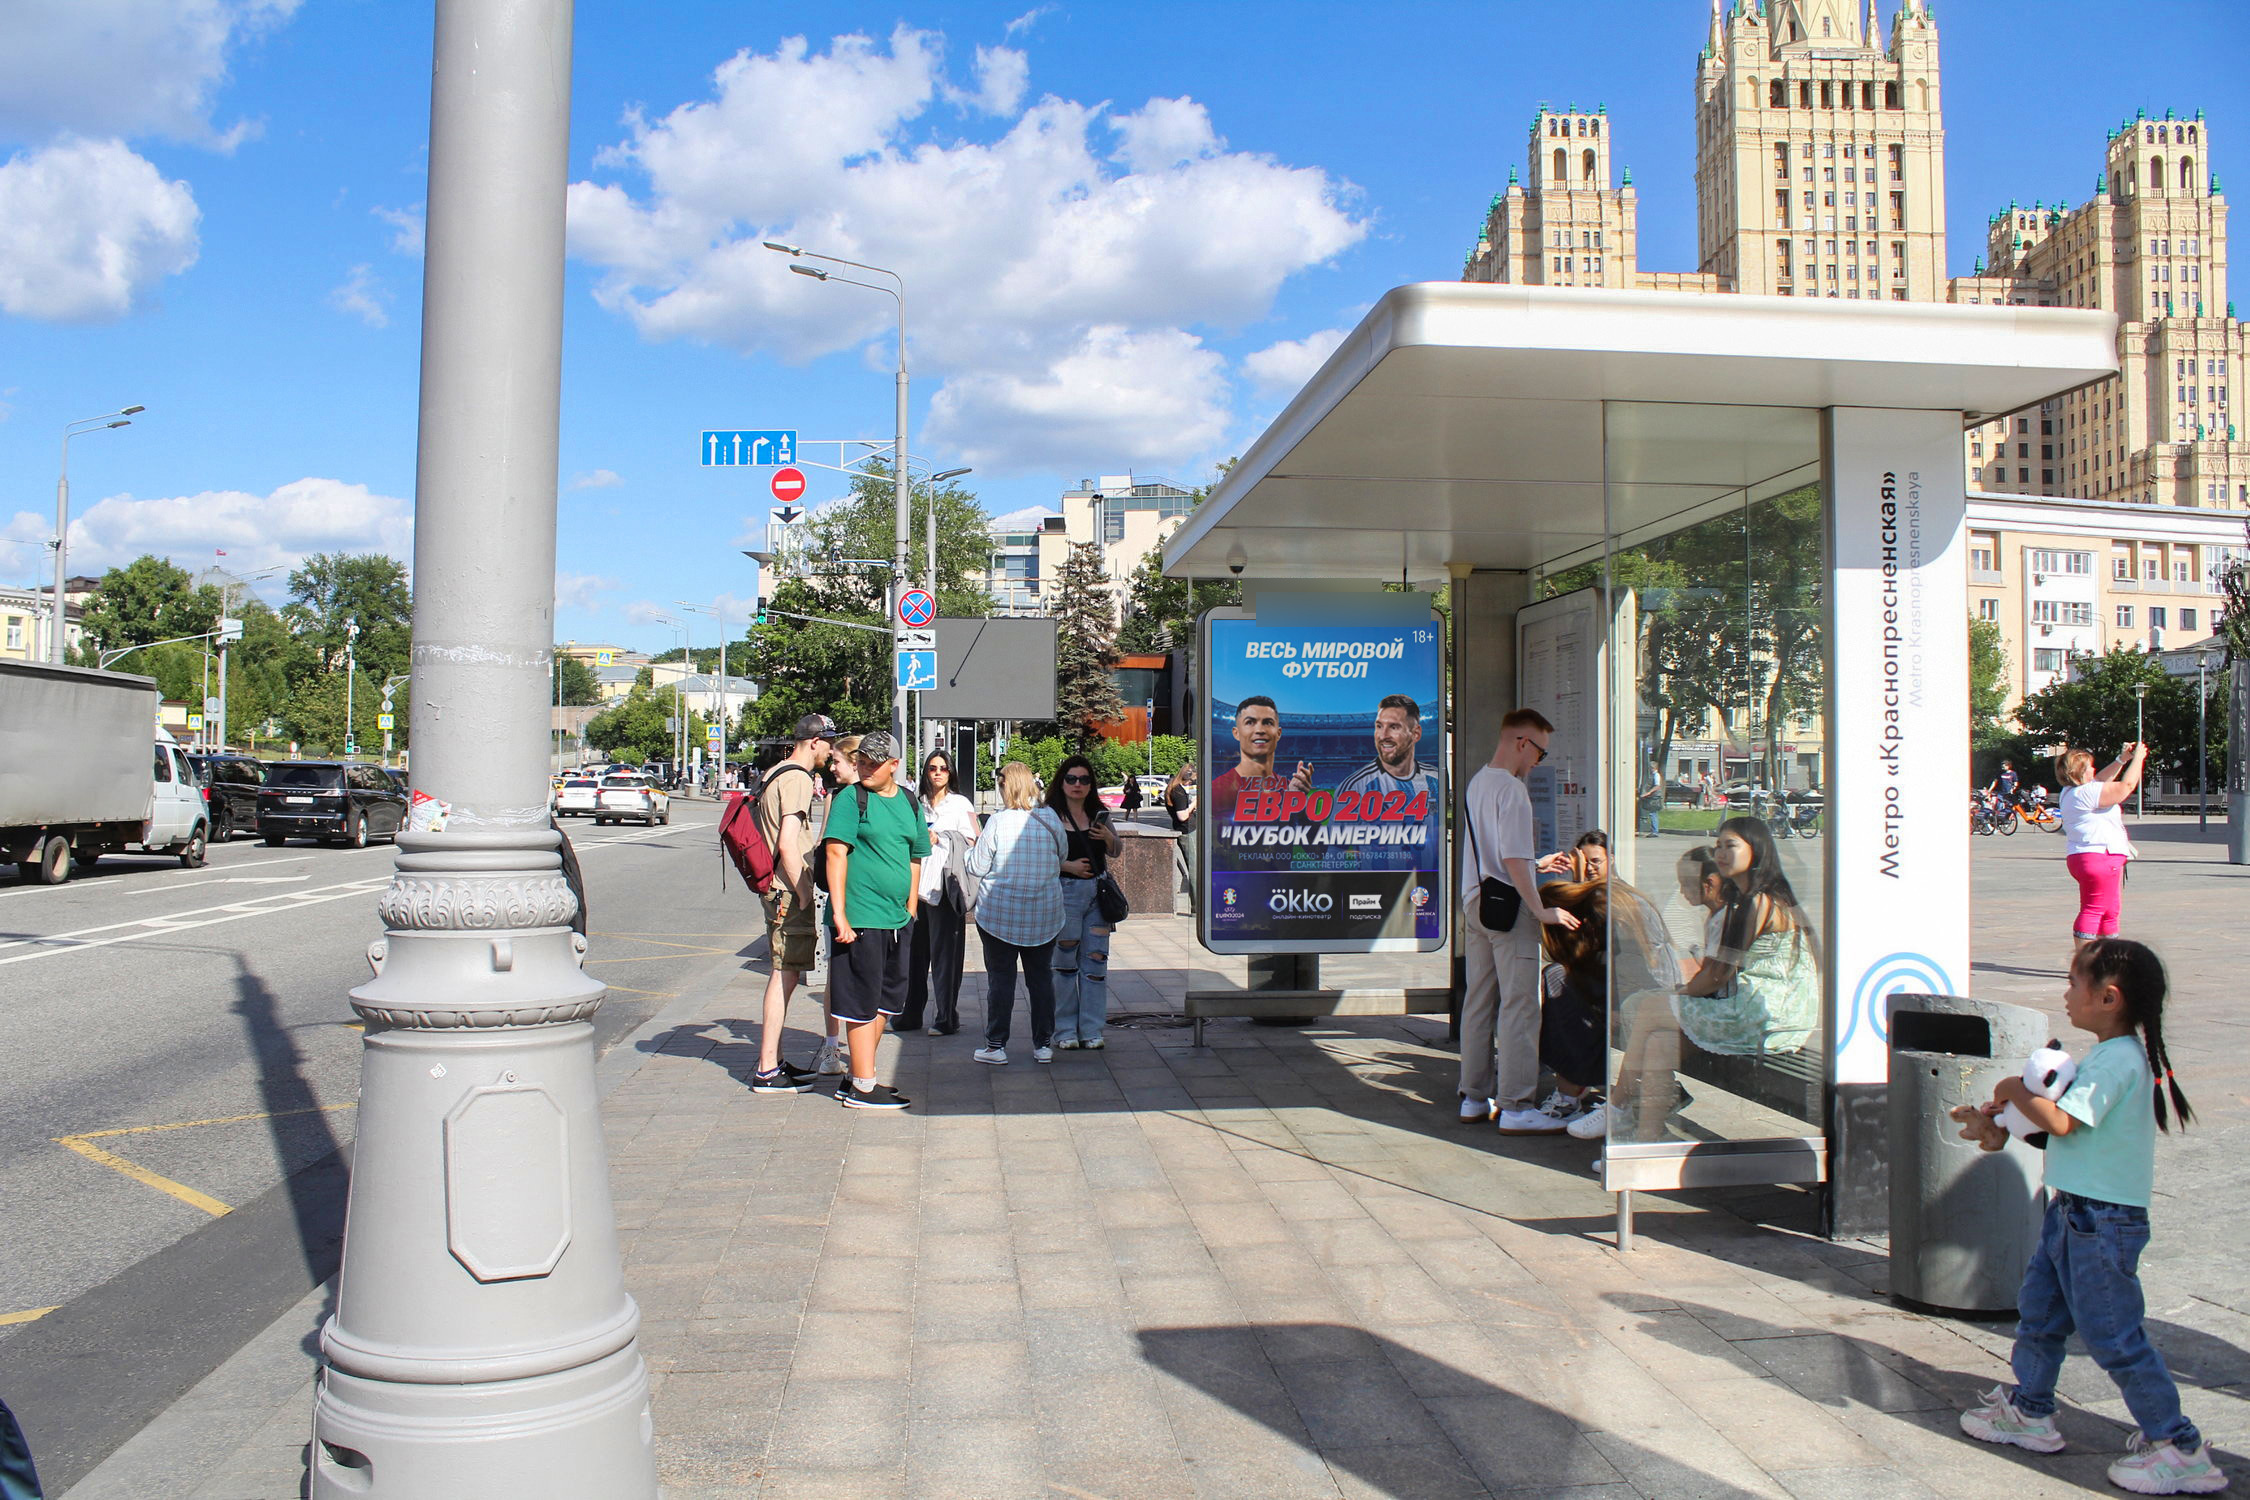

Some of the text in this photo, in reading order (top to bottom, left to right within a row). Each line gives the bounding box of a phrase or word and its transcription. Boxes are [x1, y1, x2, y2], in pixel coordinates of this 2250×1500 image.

[1905, 471, 1923, 708] Metro Krasnopresnenskaya
[1411, 630, 1435, 644] 18+
[1245, 637, 1405, 659] ВЕСЬ МИРОВОЙ
[1282, 661, 1369, 678] ФУТБОЛ
[1879, 471, 1904, 879] Метро «Краснопресненская»
[1240, 776, 1288, 791] УЕФА
[1233, 790, 1430, 822] ЕВРО 2024
[1231, 825, 1312, 846] КУБОК
[1312, 824, 1428, 846] АМЕРИКИ
[1238, 852, 1275, 860] РЕКЛАМА
[1275, 852, 1292, 860] ООО
[1336, 851, 1356, 860] ОГРН
[1296, 861, 1362, 869] САНКТ-ПЕТЕРБУРГ
[1352, 898, 1377, 906] Прайм
